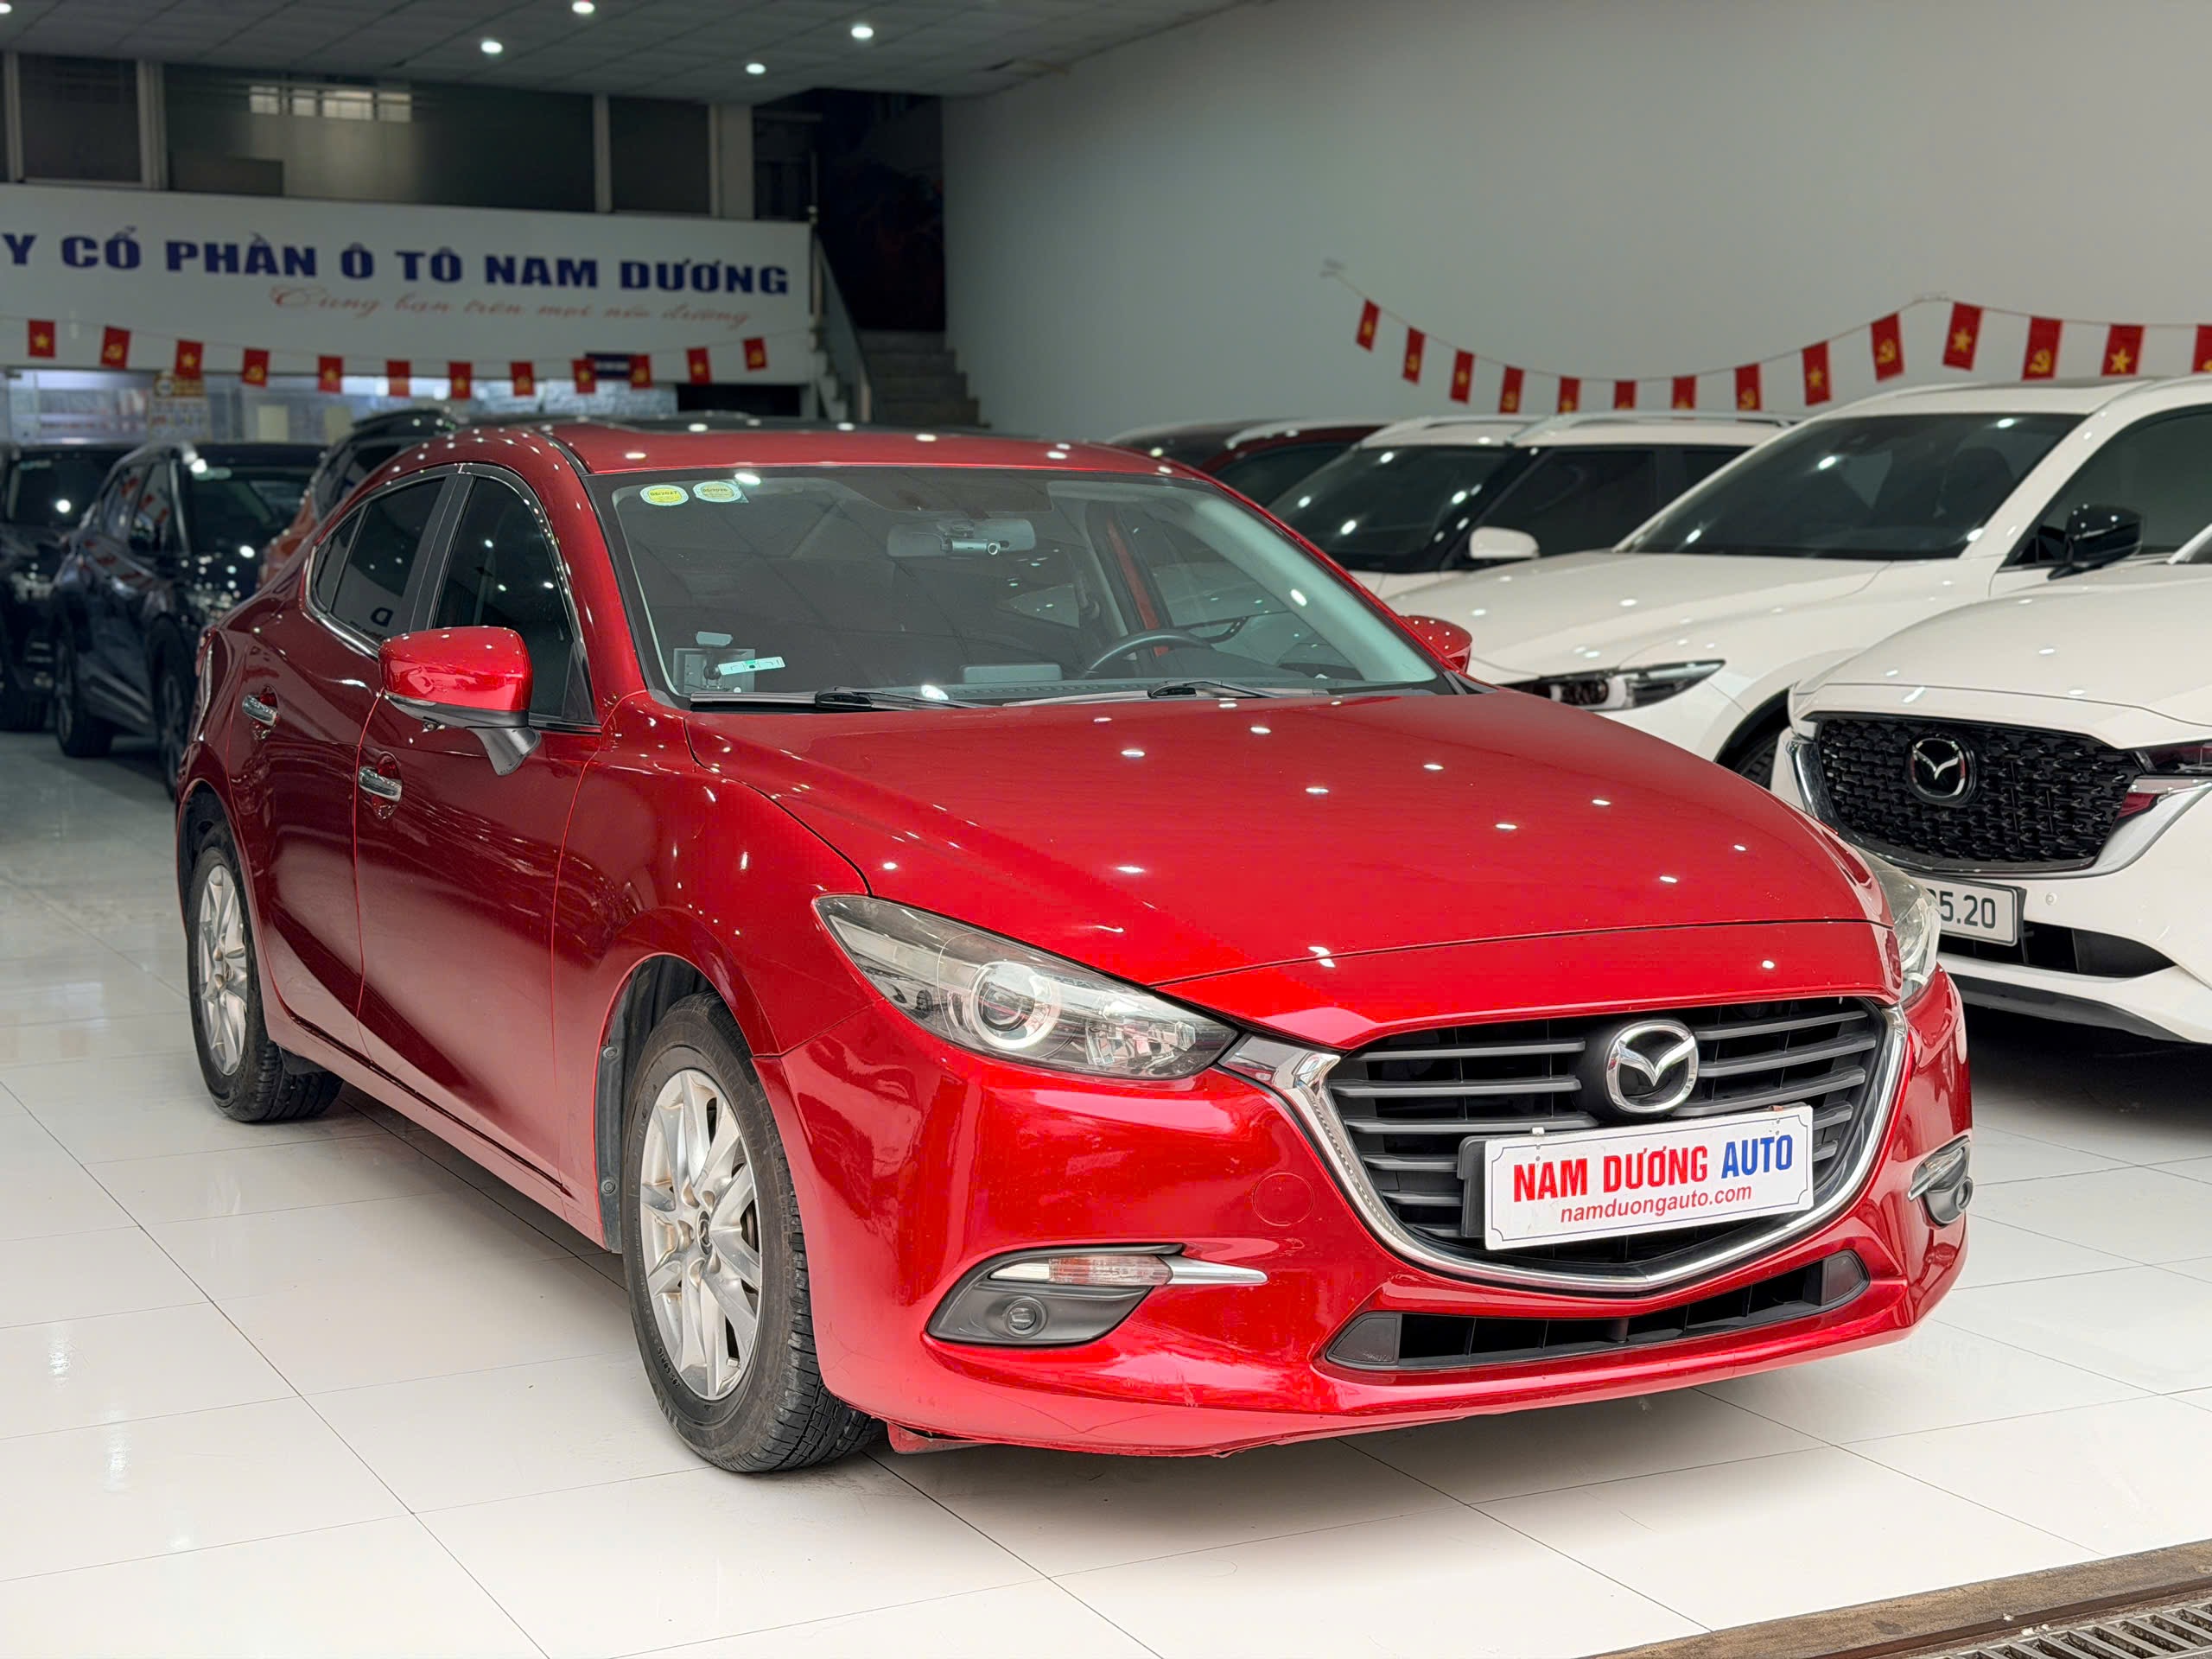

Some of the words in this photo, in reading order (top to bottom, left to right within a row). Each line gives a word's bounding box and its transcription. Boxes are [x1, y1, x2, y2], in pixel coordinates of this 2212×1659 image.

[2, 232, 37, 266] Y
[60, 226, 142, 270] CỔ
[164, 232, 317, 277] PHẦN
[340, 242, 375, 281] Ô
[395, 246, 463, 284] TÔ
[485, 255, 599, 289] NAM
[620, 258, 790, 296] DƯƠNG
[1927, 888, 1996, 929] 5.20
[1513, 1158, 1588, 1203] NAM
[1603, 1146, 1708, 1193] DƯƠNG
[1721, 1135, 1793, 1179] AUTO
[1560, 1185, 1752, 1224] namduongauto.com
